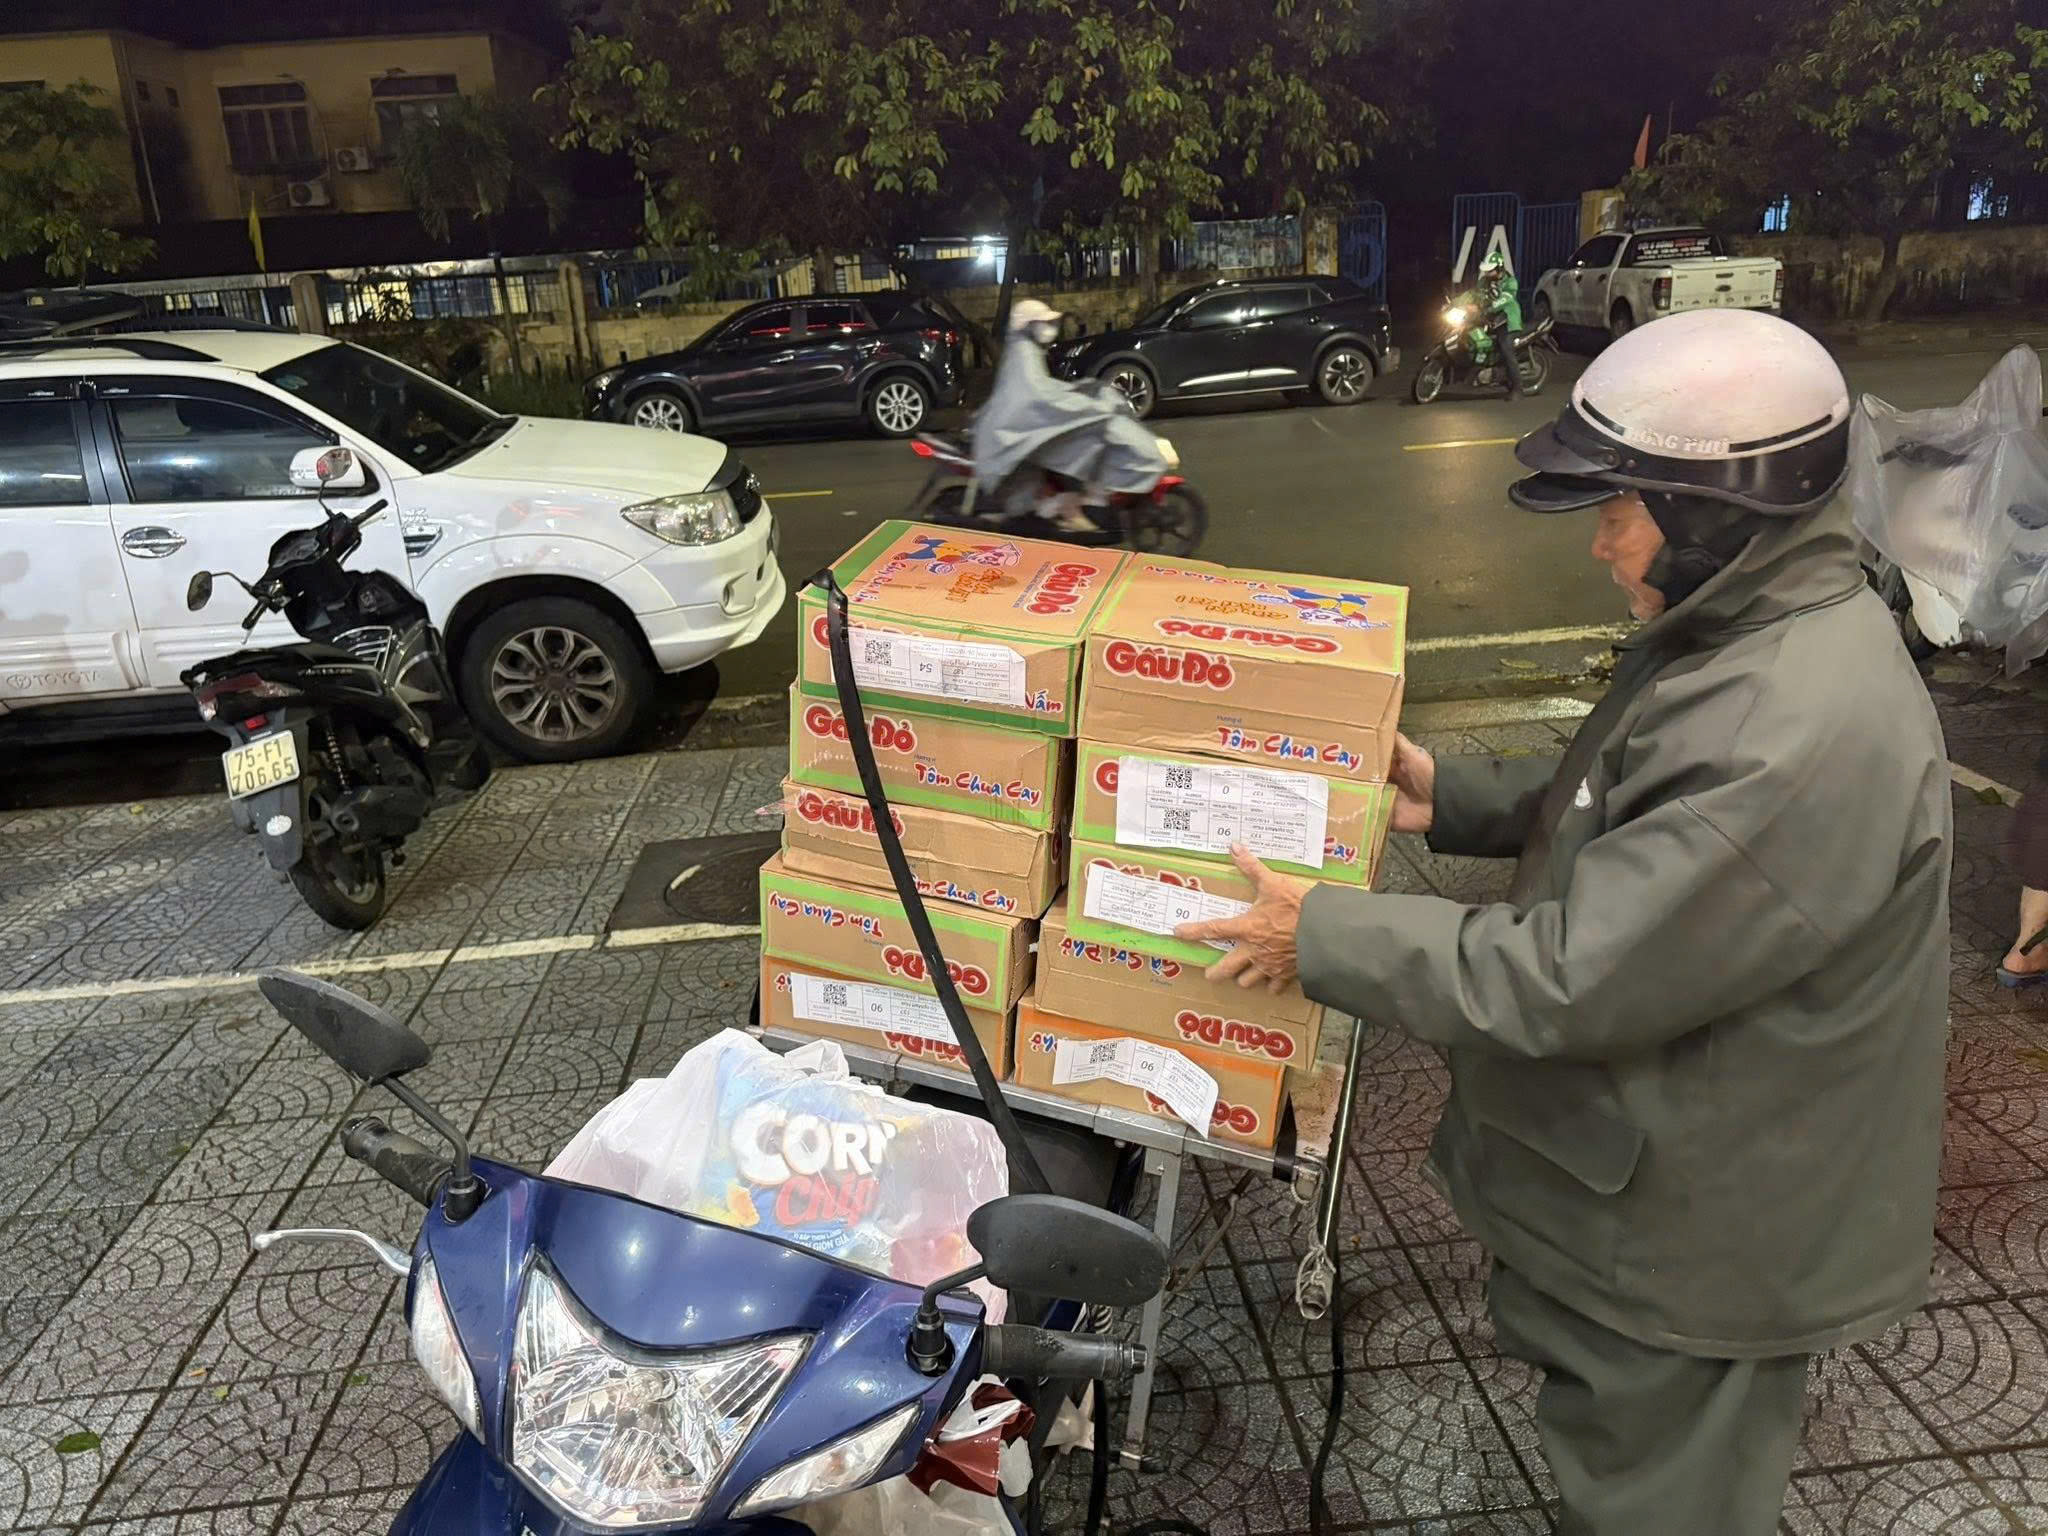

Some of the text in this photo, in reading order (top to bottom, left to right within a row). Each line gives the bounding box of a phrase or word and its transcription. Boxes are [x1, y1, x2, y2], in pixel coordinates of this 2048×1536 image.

[919, 661, 933, 673] 54
[234, 739, 282, 773] 75-F1
[1217, 727, 1363, 770] Tôm Chua Cay
[232, 756, 295, 793] 706.65
[915, 763, 1040, 805] Tôm Chua Cay
[1217, 827, 1232, 837] 90
[935, 881, 977, 903] Chua
[983, 891, 1017, 912] Cay
[769, 892, 883, 937] Tôm Chua Cay
[1175, 908, 1190, 920] 90
[870, 1003, 883, 1013] 90
[1141, 1060, 1154, 1071] 90
